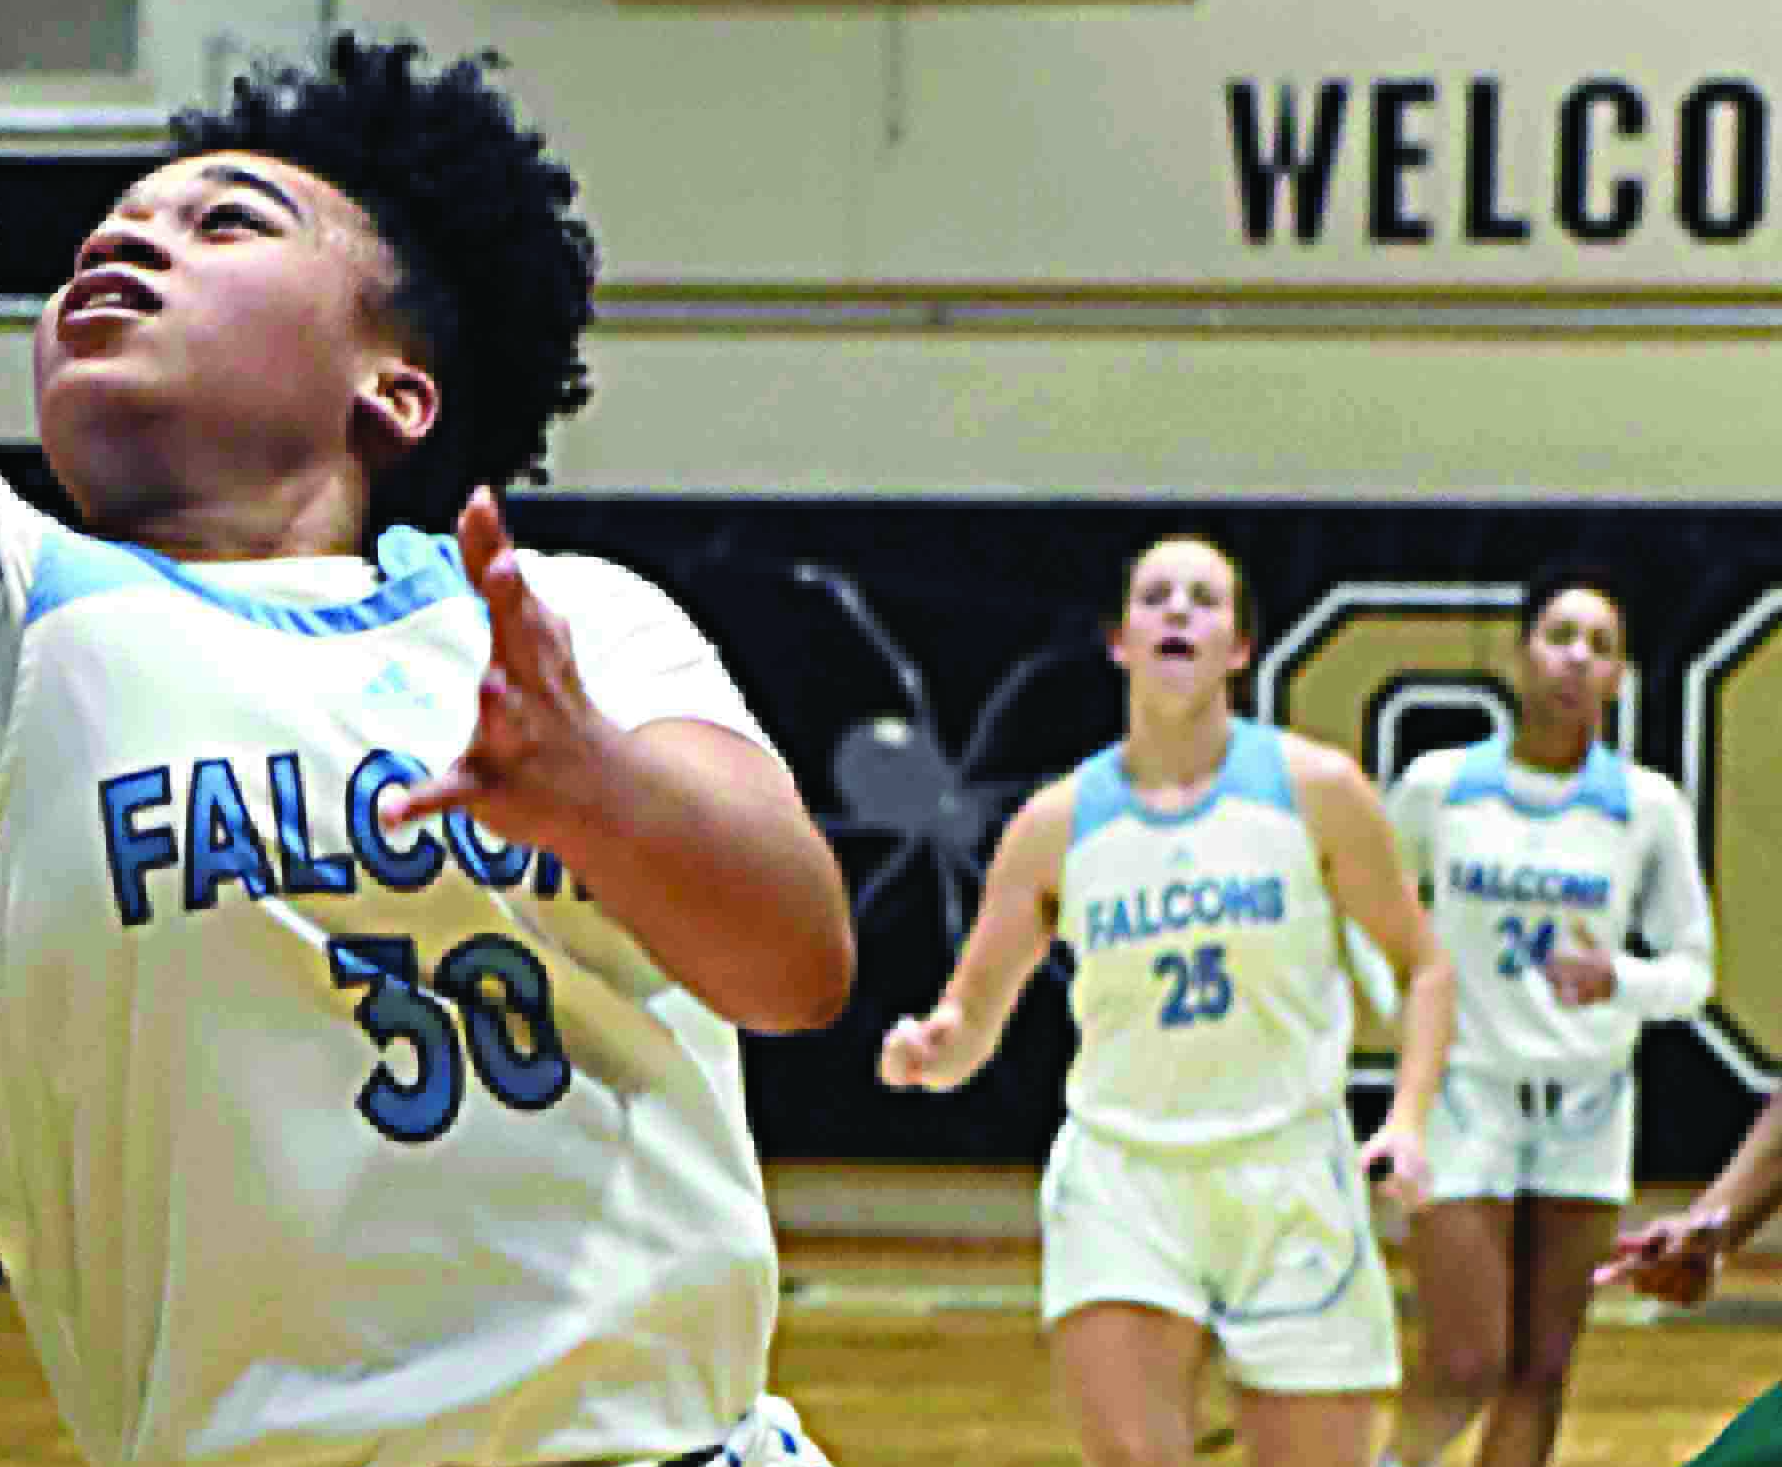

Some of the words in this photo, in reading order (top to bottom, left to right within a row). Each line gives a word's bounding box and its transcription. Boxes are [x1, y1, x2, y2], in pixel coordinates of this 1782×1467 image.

[1224, 78, 1770, 245] WELCO
[98, 748, 596, 927] FALCO
[1448, 863, 1611, 911] FALCONS
[1086, 875, 1286, 951] FALCONS
[326, 934, 573, 1143] 30
[1154, 943, 1235, 1028] 25
